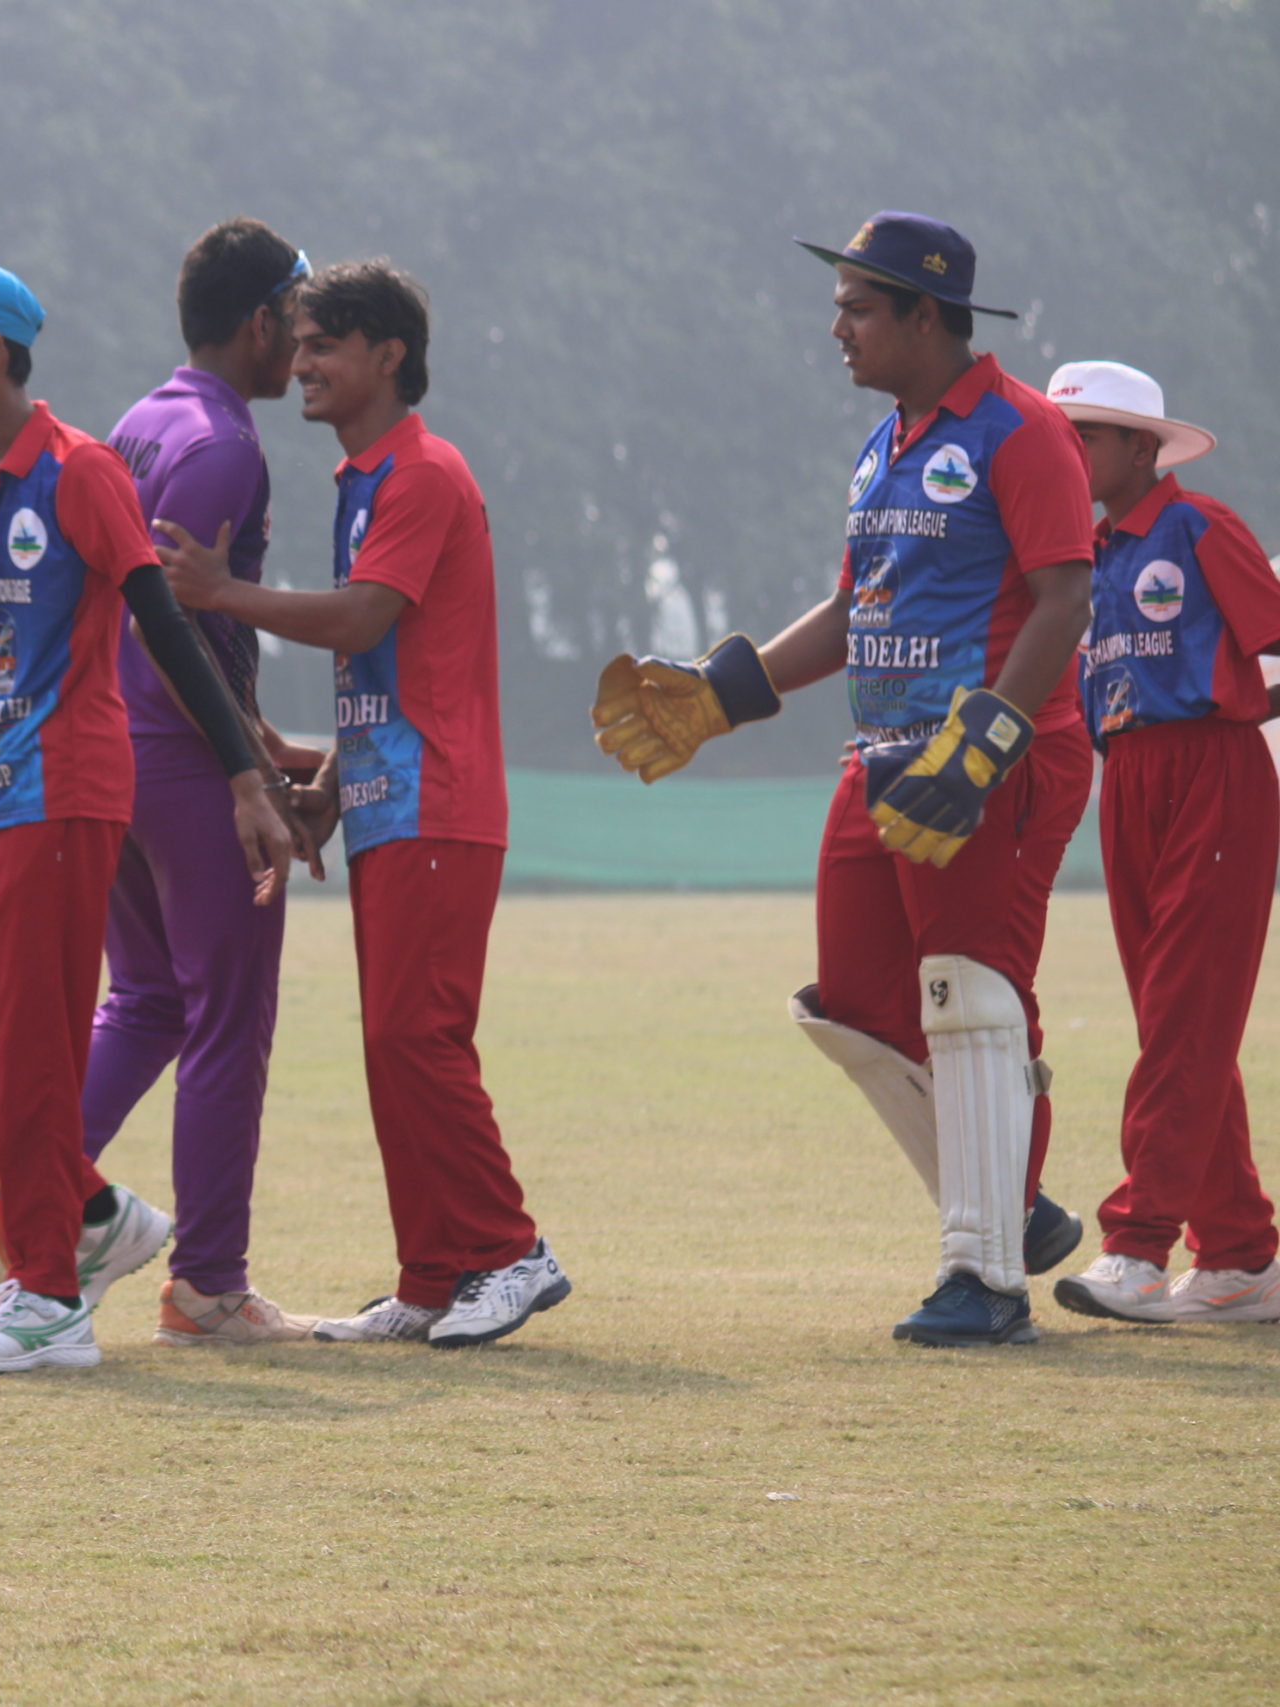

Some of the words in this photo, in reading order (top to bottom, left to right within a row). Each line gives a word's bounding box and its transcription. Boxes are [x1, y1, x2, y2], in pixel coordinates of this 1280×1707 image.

[907, 509, 947, 538] LEAGUE
[864, 634, 940, 668] DELHI
[1134, 630, 1173, 657] LEAGUE
